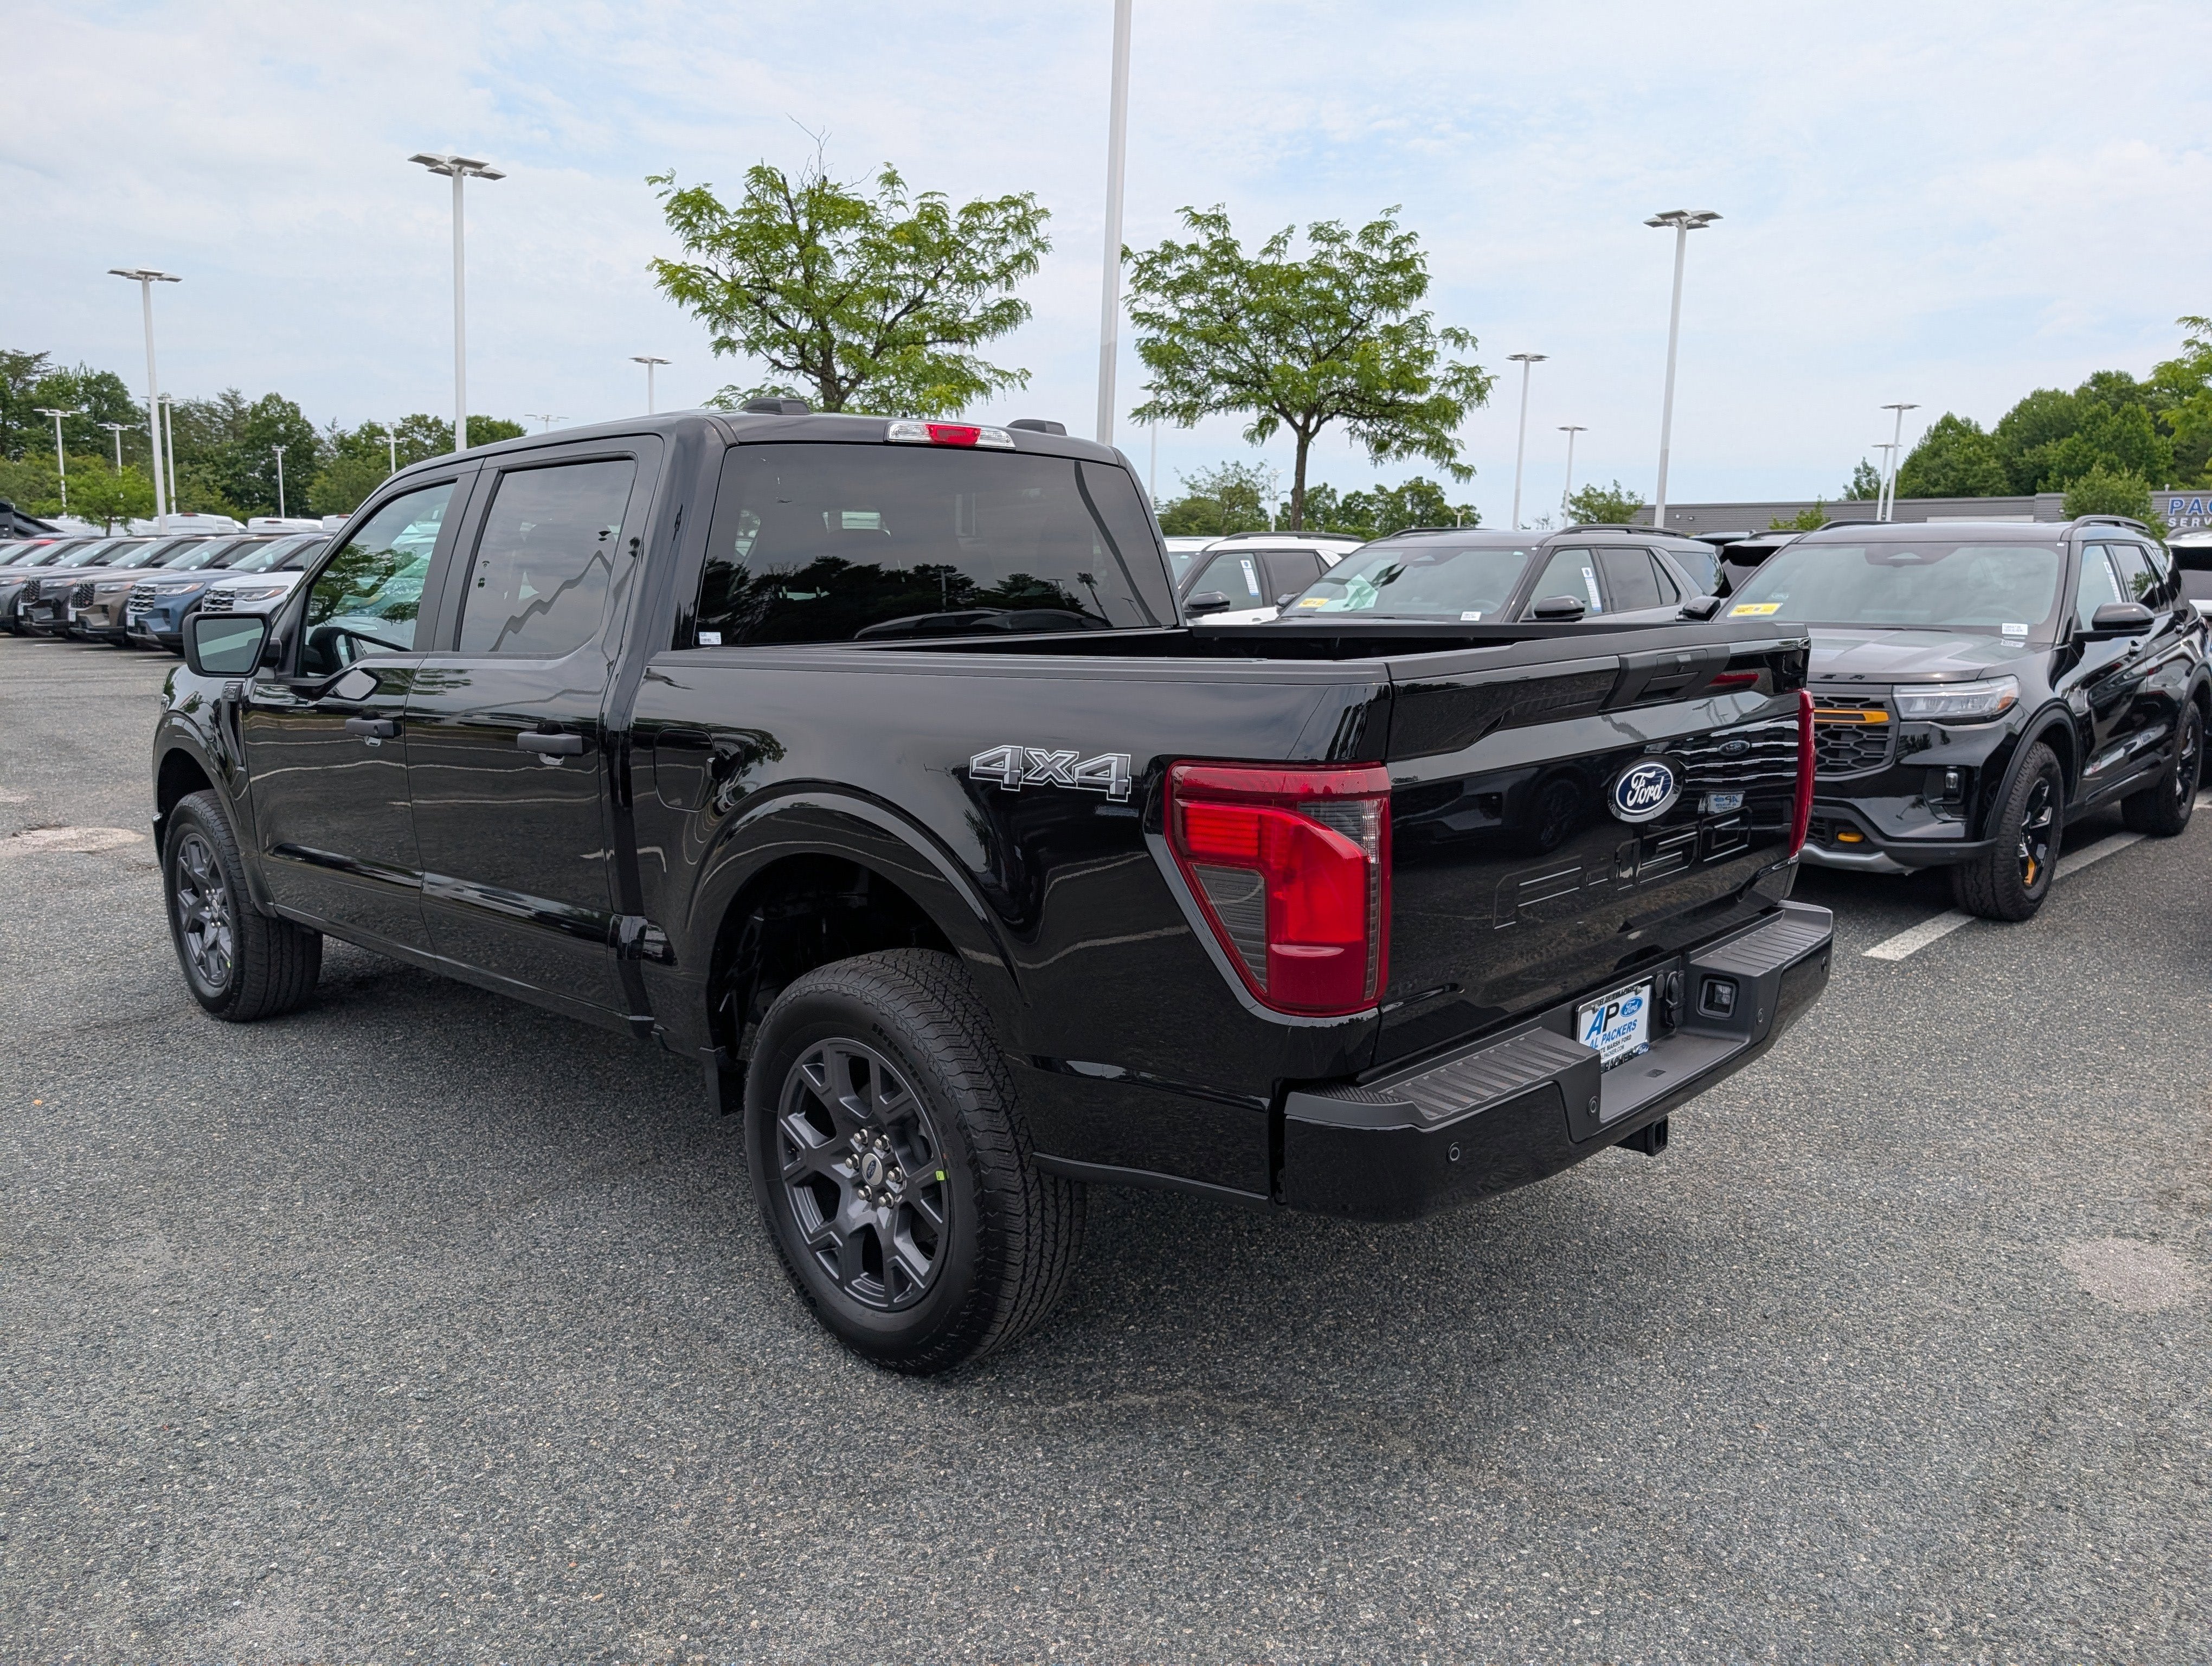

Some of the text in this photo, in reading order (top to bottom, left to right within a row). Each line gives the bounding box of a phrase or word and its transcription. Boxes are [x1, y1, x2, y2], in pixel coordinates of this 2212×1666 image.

[1626, 770, 1666, 808] Ford
[1623, 999, 1639, 1016] Ford
[1584, 1002, 1620, 1041] AP
[1601, 1019, 1637, 1046] PACKERS
[1606, 1039, 1621, 1050] MARSH
[1621, 1034, 1632, 1043] FORD
